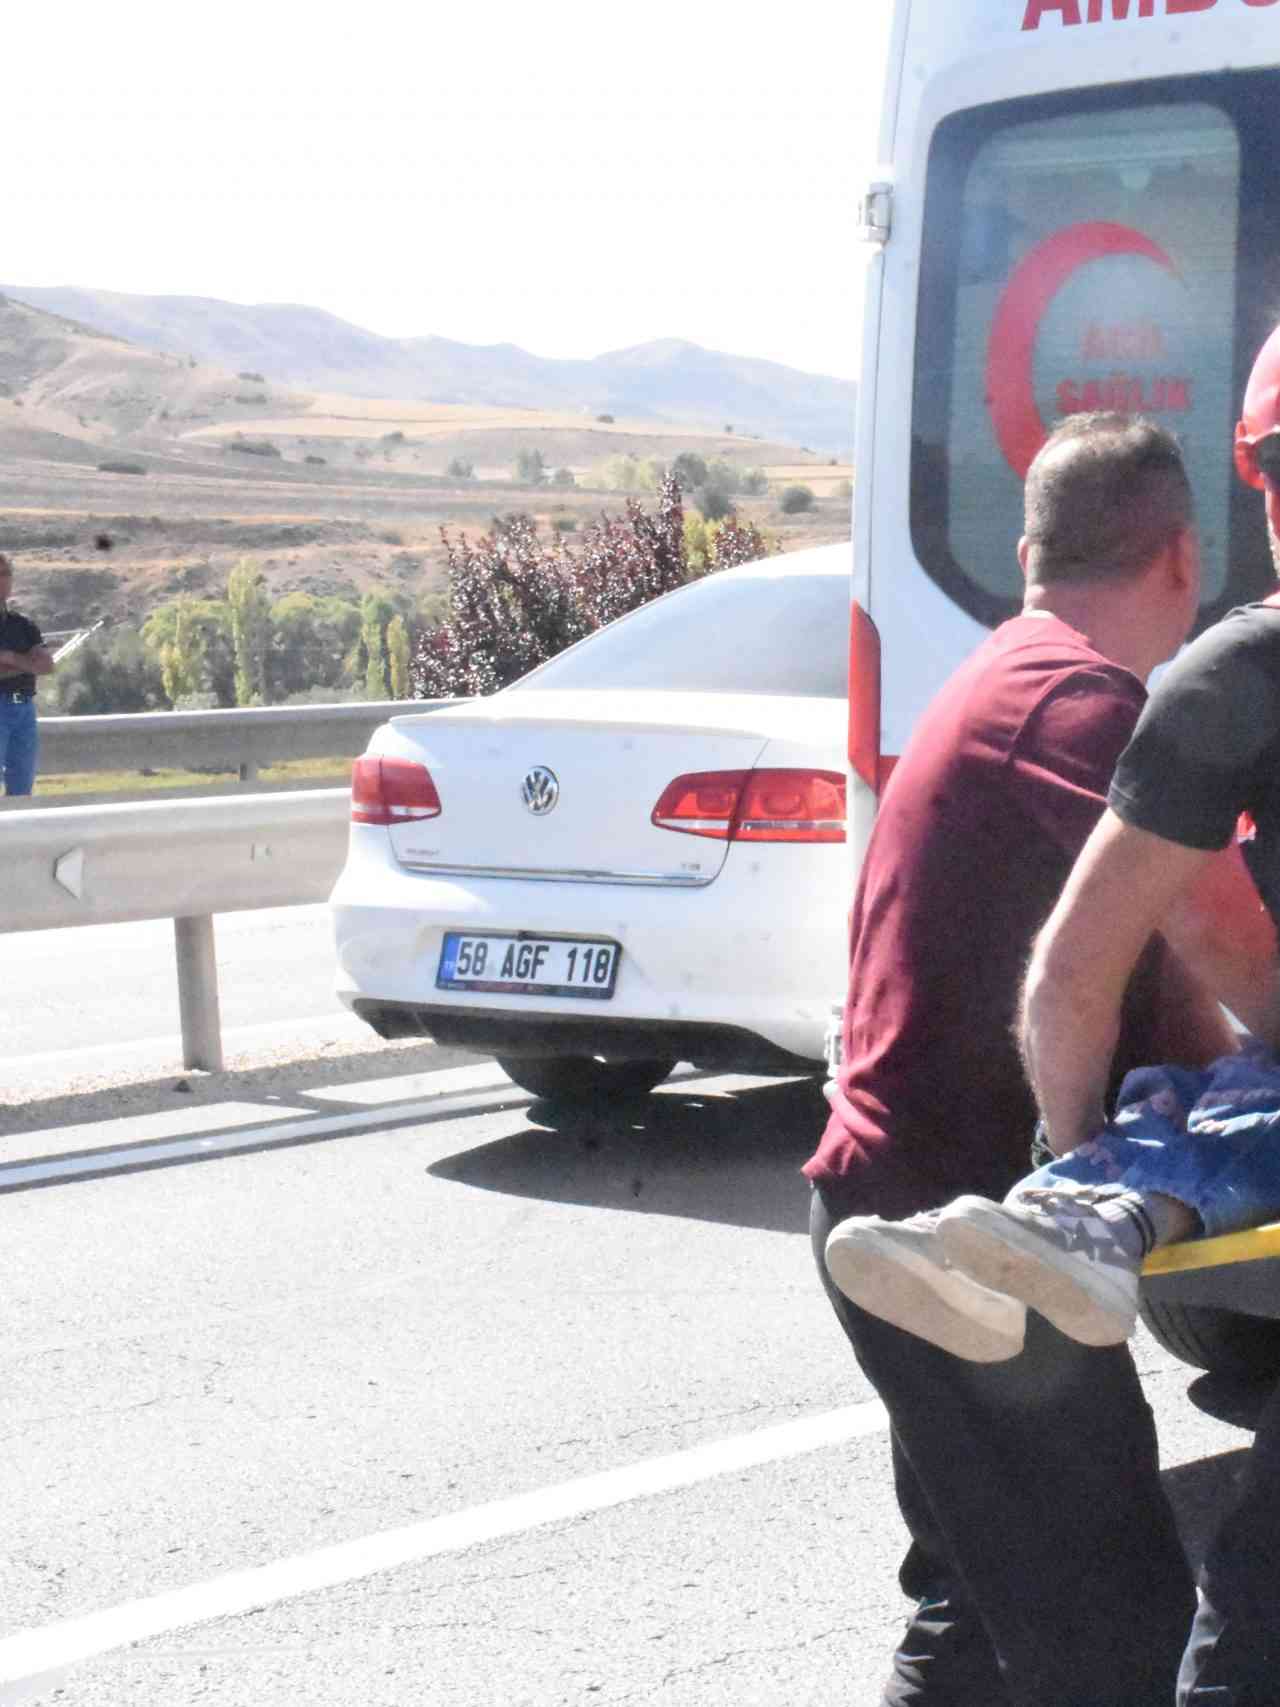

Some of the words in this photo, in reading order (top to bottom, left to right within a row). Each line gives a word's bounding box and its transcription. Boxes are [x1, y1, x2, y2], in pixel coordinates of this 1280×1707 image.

[456, 941, 489, 977] 58
[500, 943, 550, 980] AGF
[566, 947, 611, 985] 118
